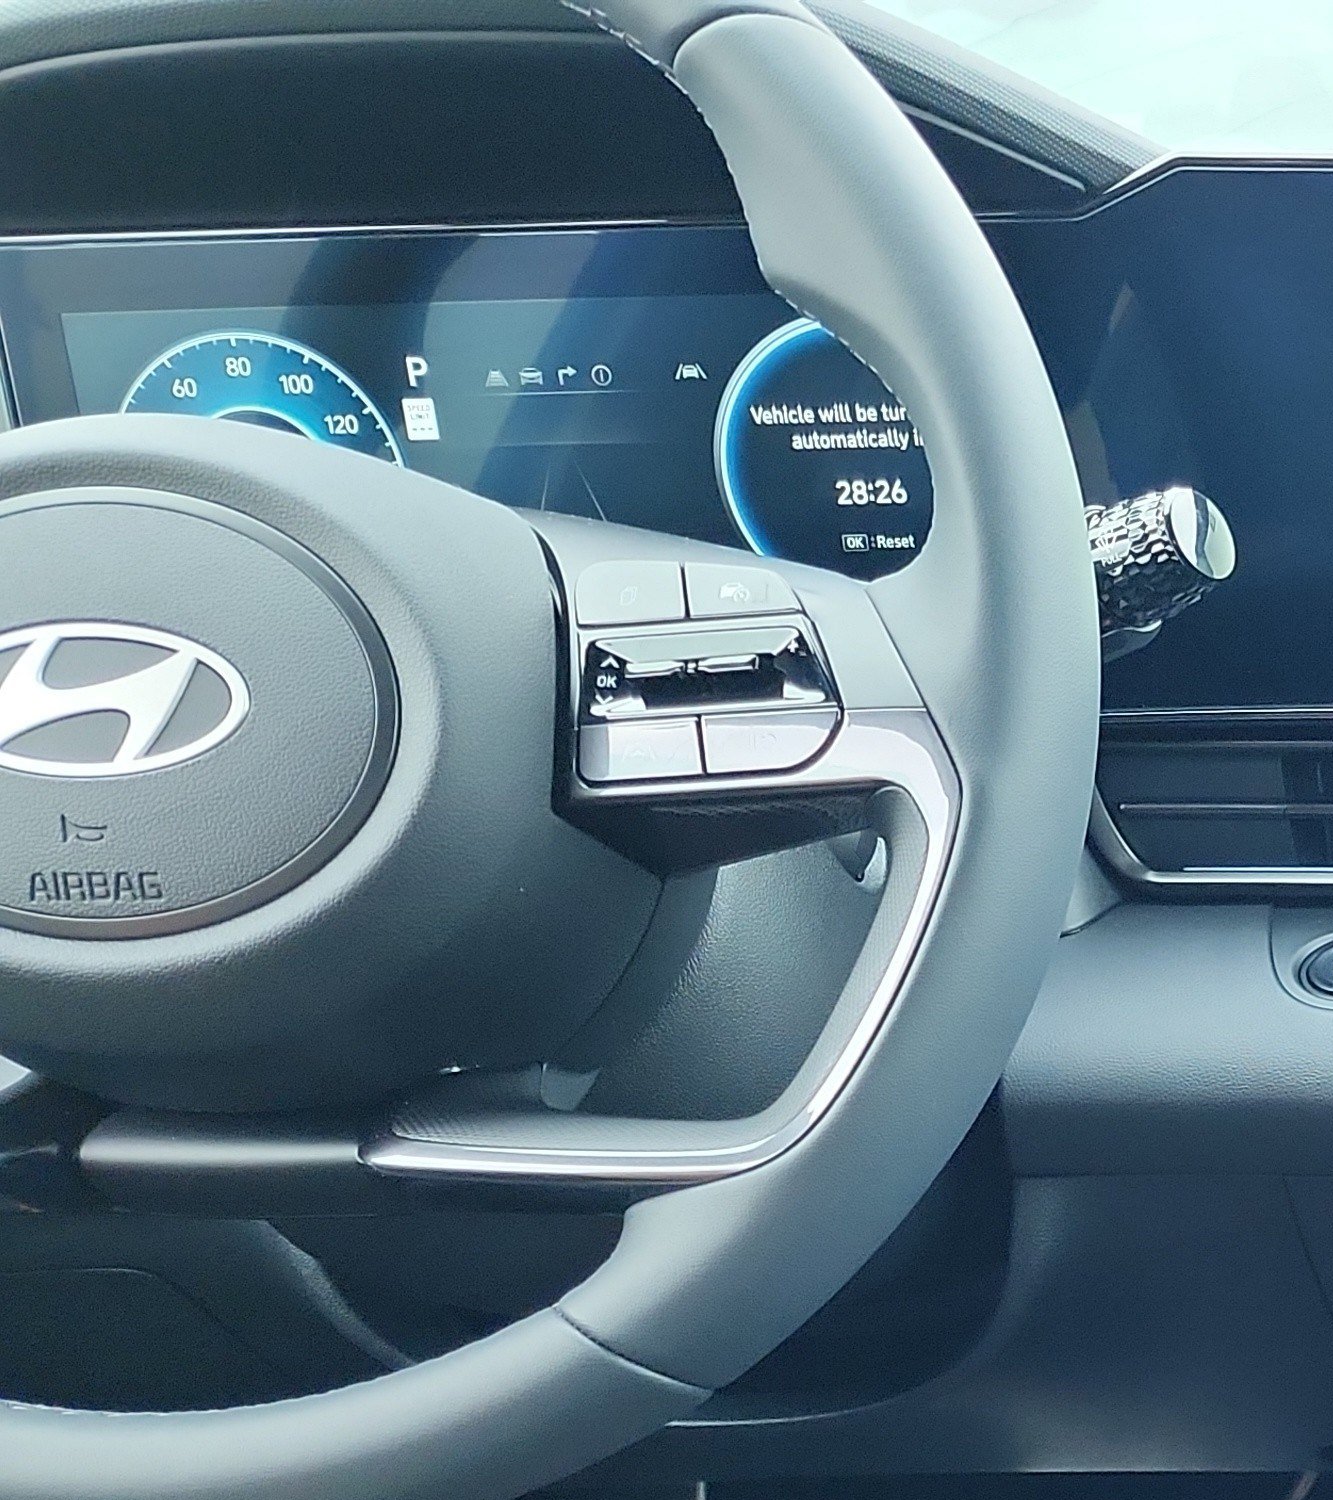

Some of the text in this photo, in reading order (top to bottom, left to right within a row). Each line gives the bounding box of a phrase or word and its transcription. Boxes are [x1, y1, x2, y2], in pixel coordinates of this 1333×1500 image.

[225, 356, 252, 378] 80
[405, 355, 429, 388] P
[171, 376, 198, 399] 60
[278, 374, 314, 396] 100
[323, 413, 360, 436] 120
[750, 402, 909, 425] Vehicle will be tur
[791, 426, 909, 451] automatically
[835, 478, 908, 506] 28:26
[846, 535, 865, 549] OK
[596, 674, 618, 689] OK
[27, 869, 165, 903] AIRBAG
